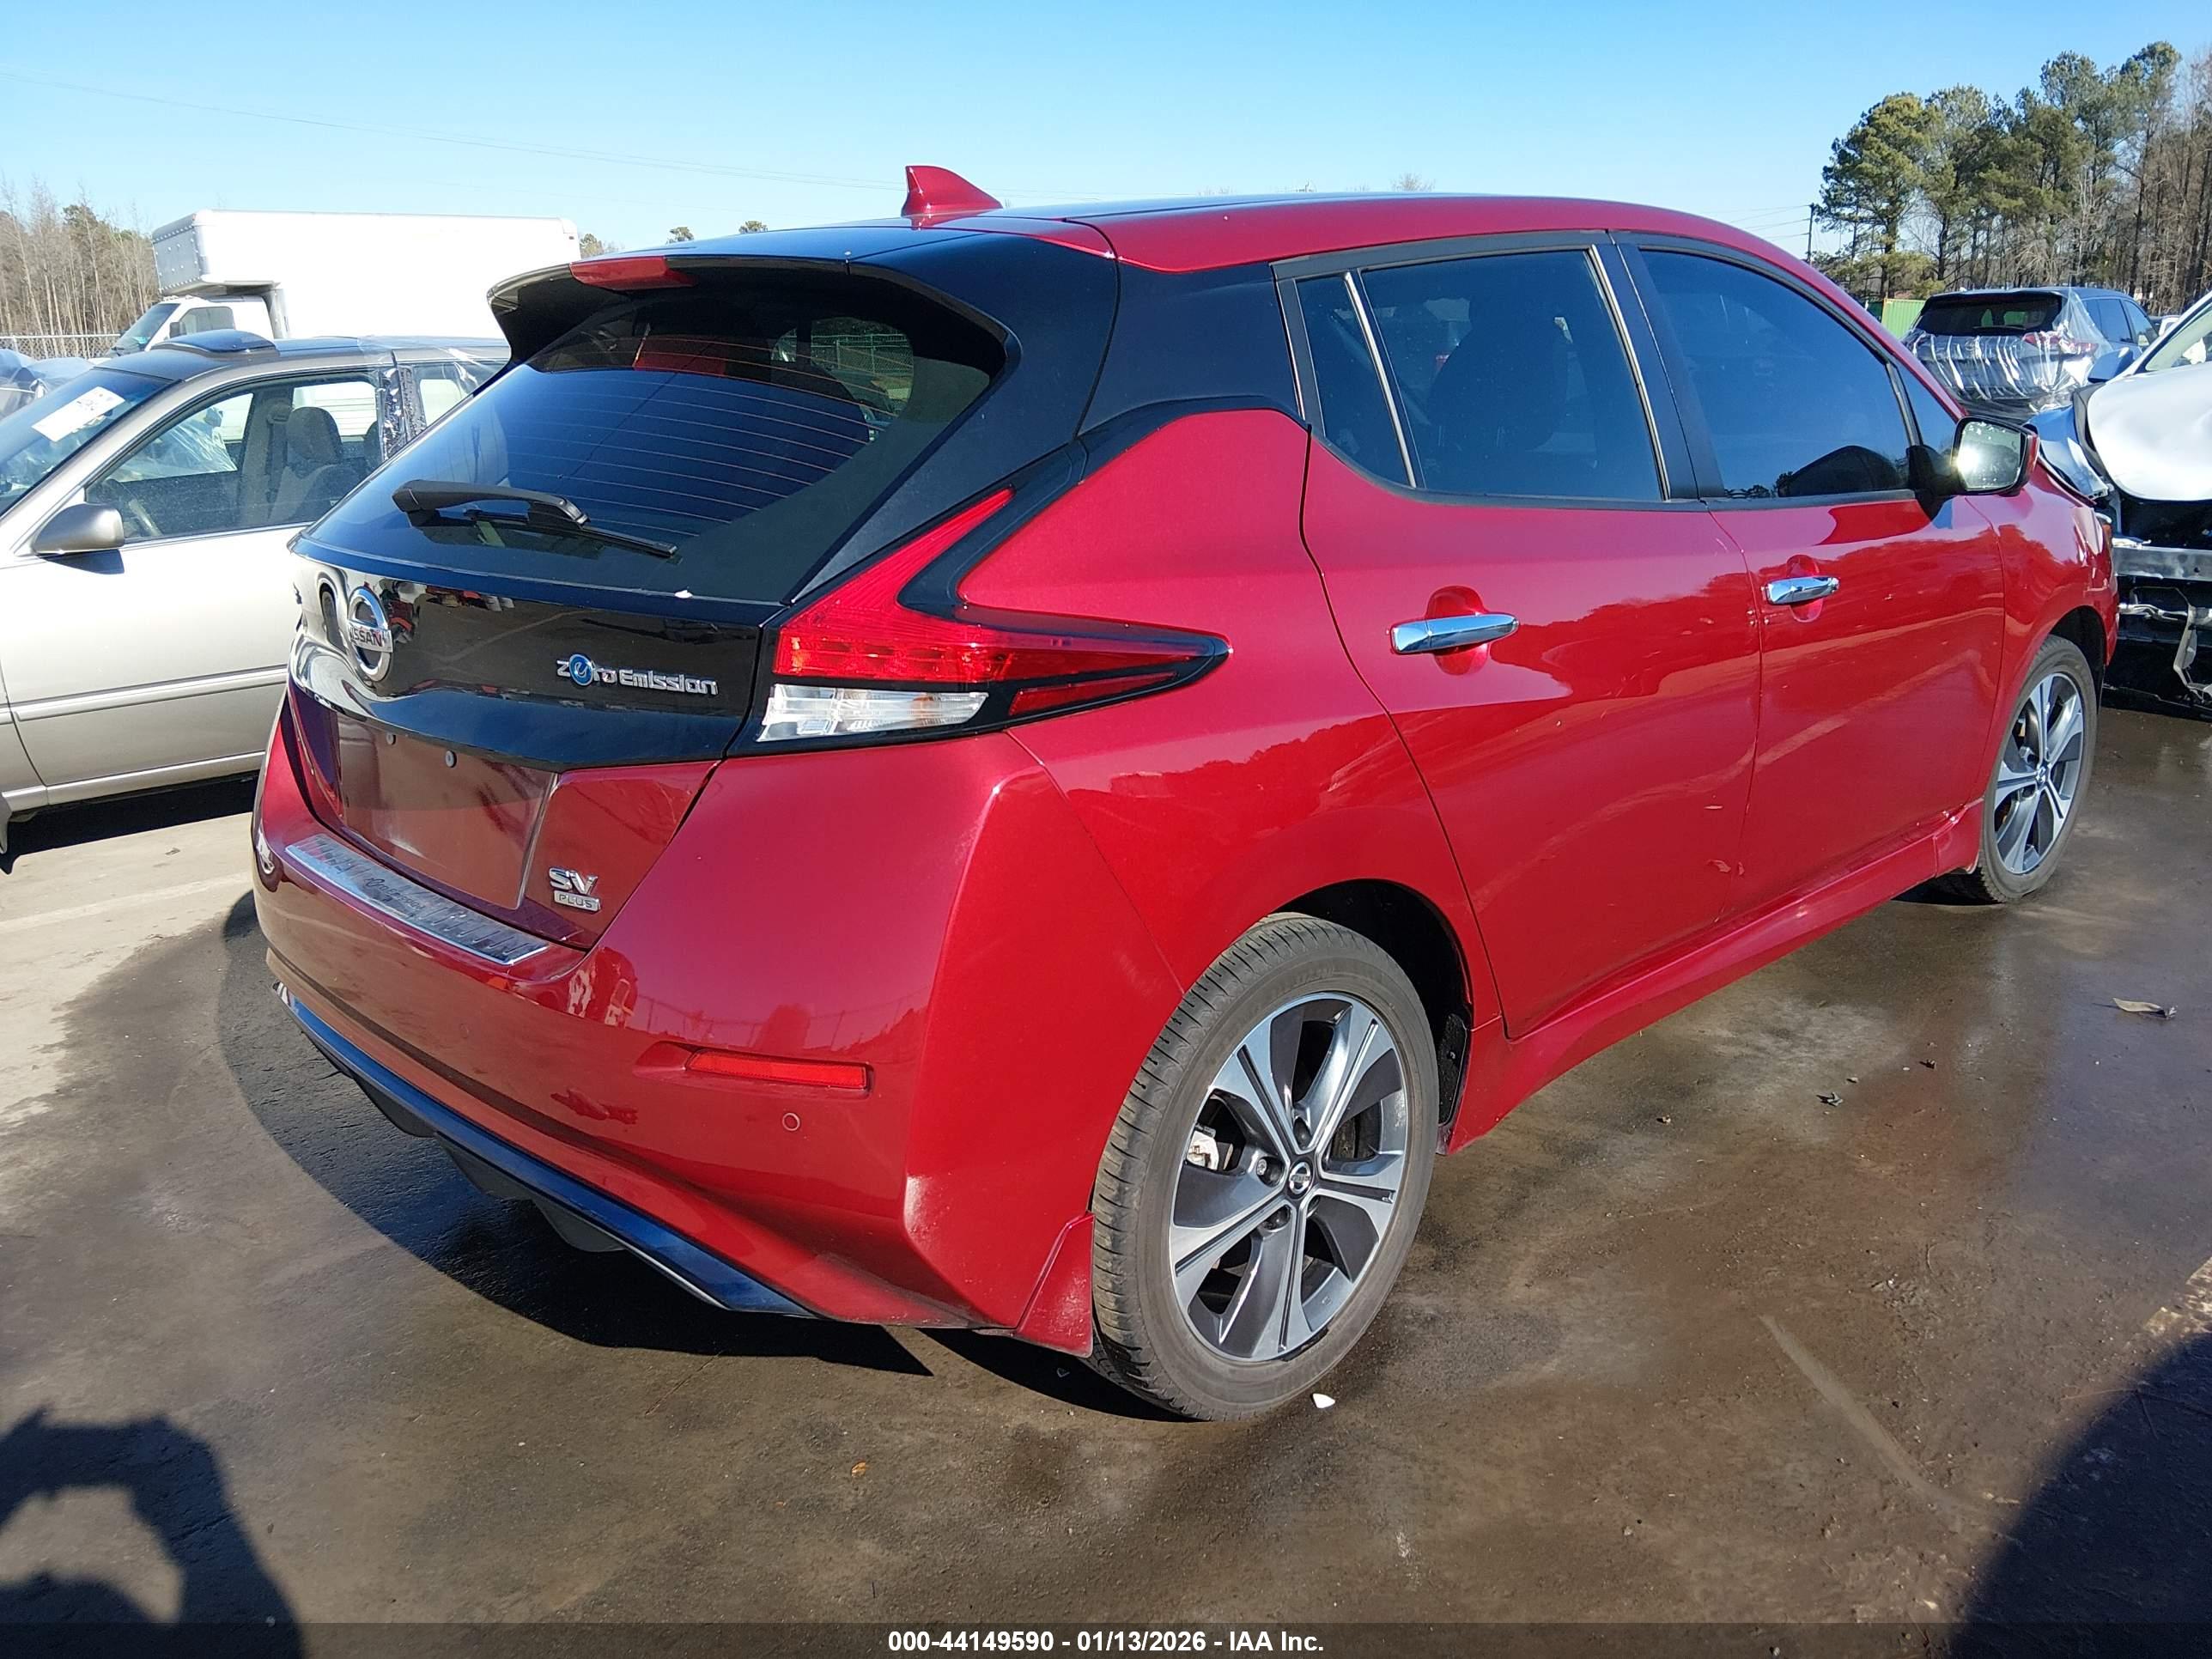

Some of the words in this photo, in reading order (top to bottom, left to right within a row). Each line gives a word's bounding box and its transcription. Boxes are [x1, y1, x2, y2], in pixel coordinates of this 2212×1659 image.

[618, 669, 719, 696] Emission
[549, 867, 599, 895] SV
[559, 894, 592, 908] PLUS
